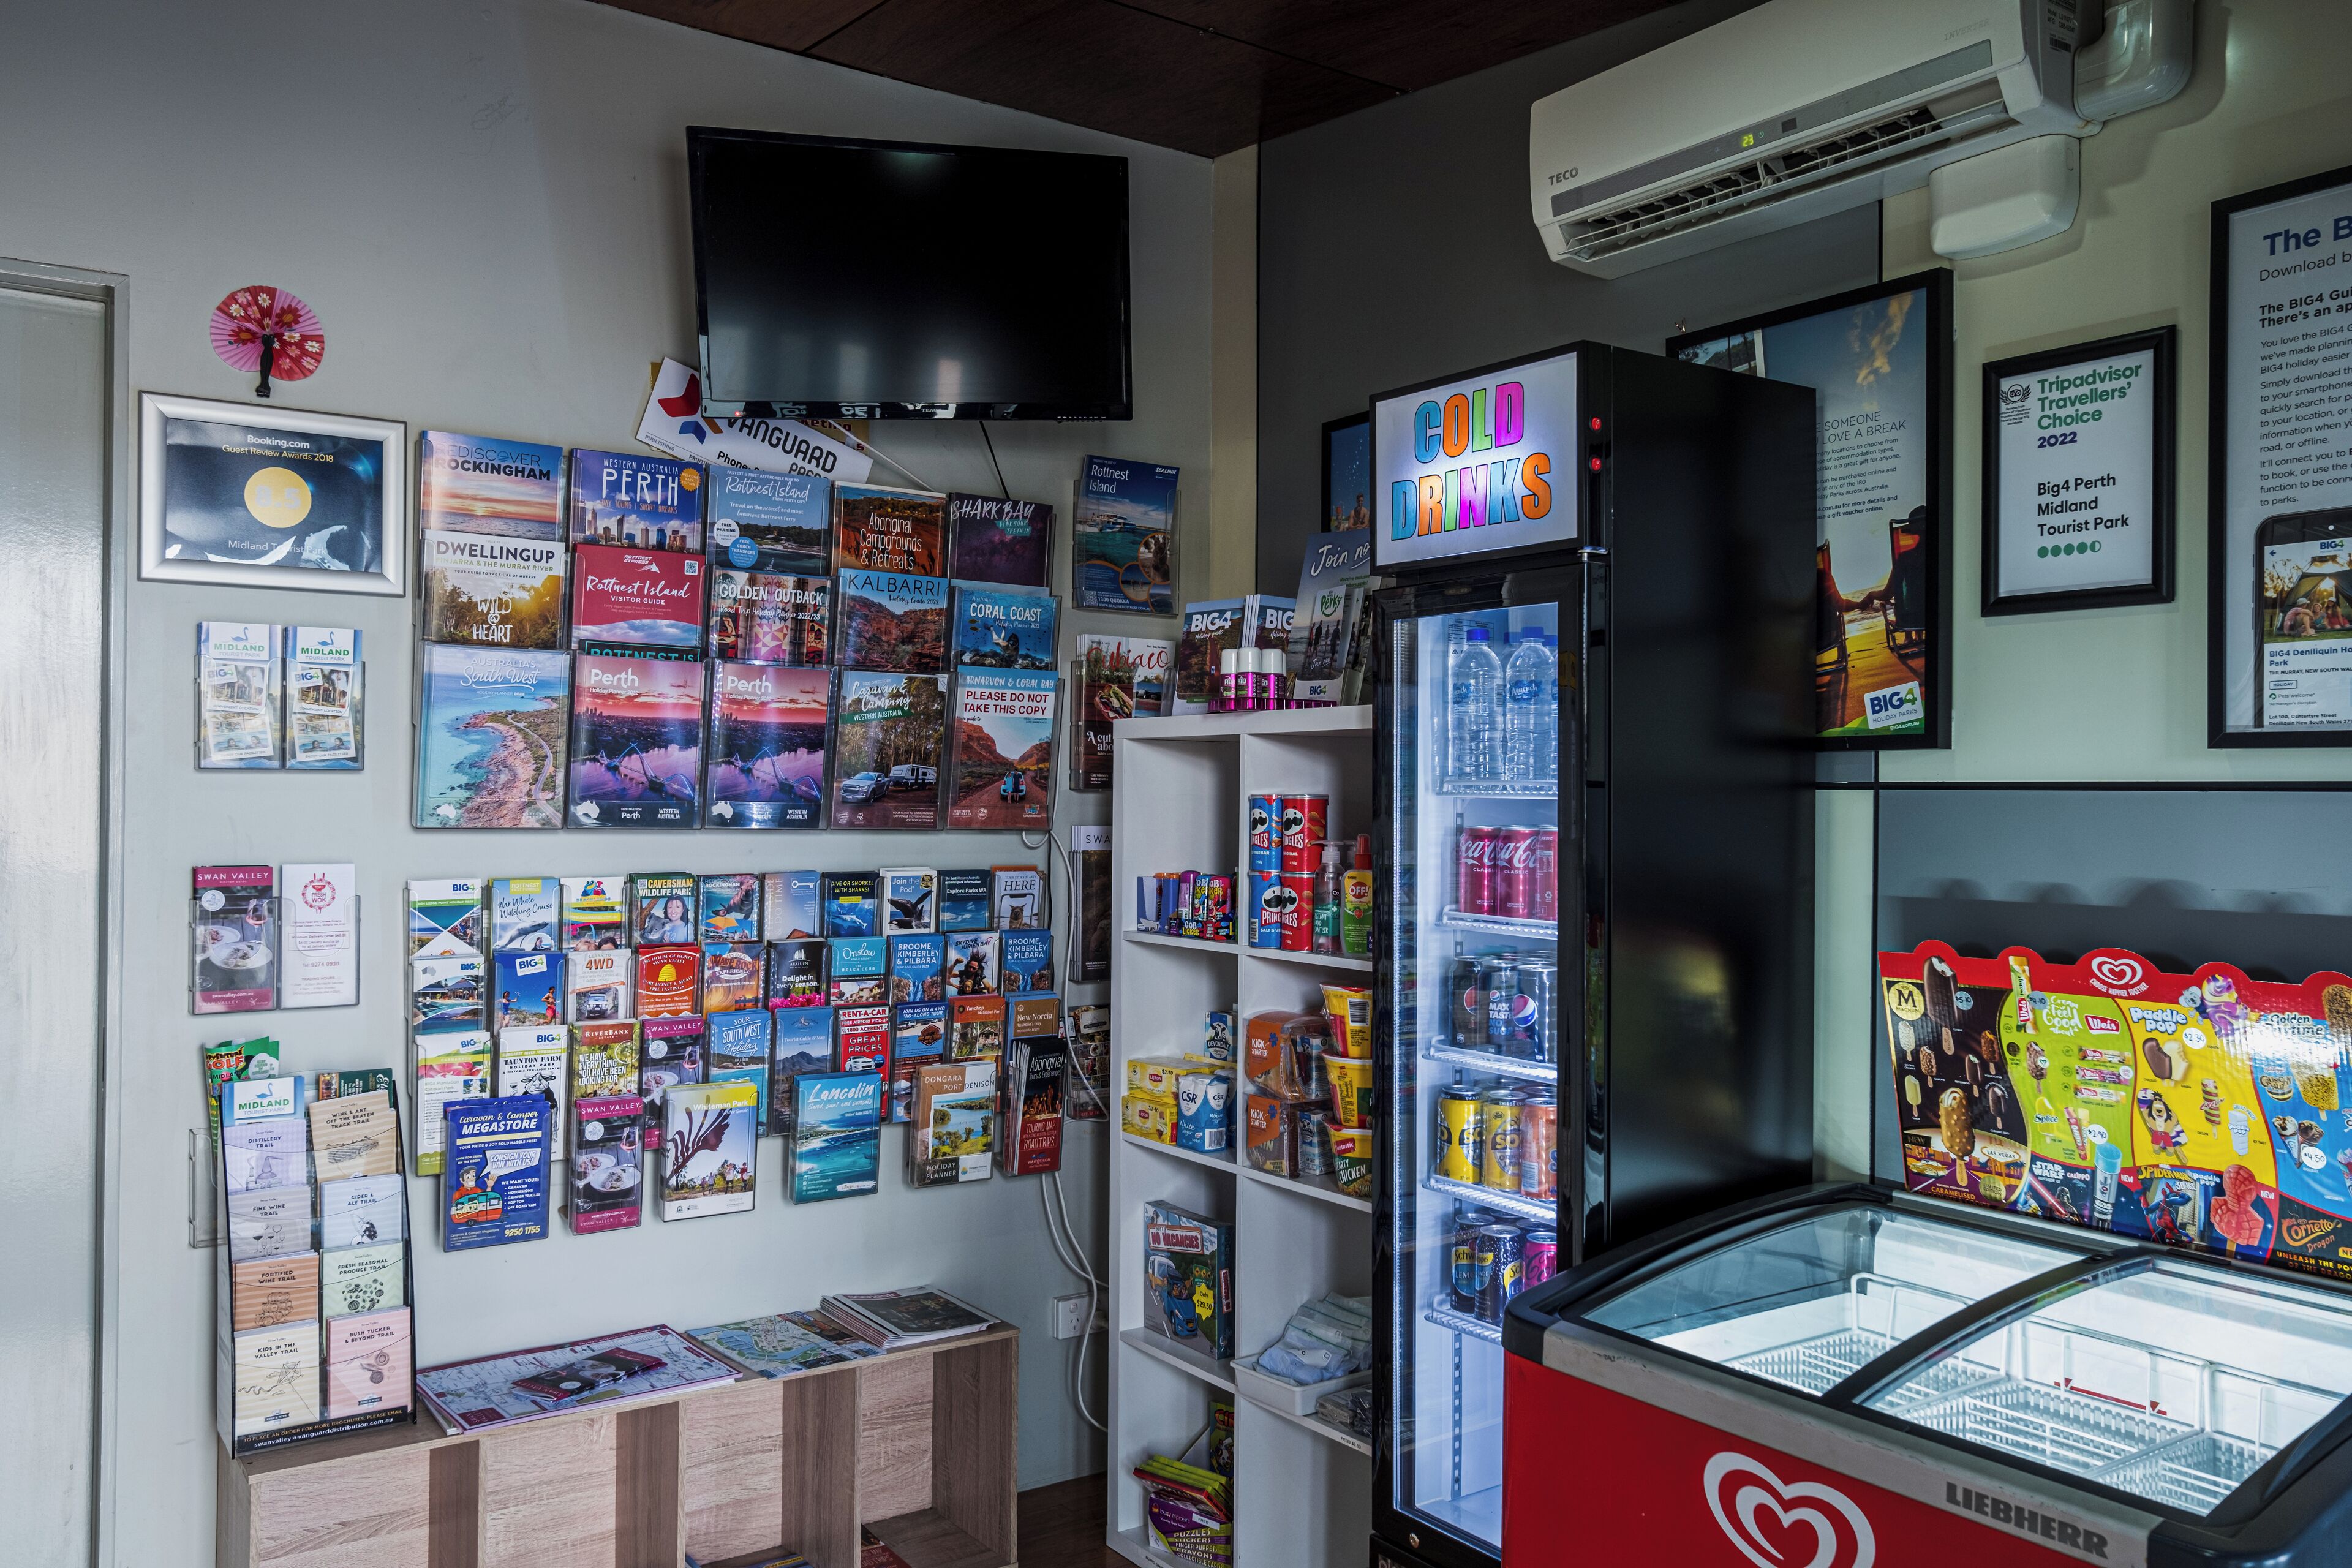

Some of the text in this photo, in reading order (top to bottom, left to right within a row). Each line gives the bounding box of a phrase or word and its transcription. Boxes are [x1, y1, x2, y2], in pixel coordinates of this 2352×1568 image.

[1741, 134, 1754, 148] 23
[1548, 167, 1578, 186] TECO
[2263, 228, 2321, 256] The
[2260, 254, 2335, 281] Download
[2260, 293, 2324, 315] The BIG4
[2037, 363, 2142, 396] Tripadvisor
[2261, 368, 2341, 391] Simply download
[1414, 381, 1524, 464] COLD
[1824, 410, 1882, 430] SOMEONE
[2037, 408, 2103, 431] Choice
[1822, 419, 1907, 445] LOVE A BREAK
[2260, 421, 2341, 440] information when
[247, 435, 310, 449] Booking.com
[727, 418, 837, 473] VANGUARD
[2037, 431, 2078, 449] 2022
[222, 445, 334, 462] Guest Review Awards 2018
[435, 458, 551, 481] ROCKINGHAM
[604, 458, 679, 474] WESTERN AUSTRALIA
[1091, 464, 1129, 480] Rottnest
[602, 468, 679, 506] PERTH
[726, 476, 810, 502] Rottnest Island
[1089, 480, 1117, 494] Island
[2037, 473, 2116, 497] Big4 Perth
[254, 485, 301, 508] 8.5
[1392, 453, 1551, 541] DRINKS
[601, 499, 677, 514] DAY TOURS SHORT BREAKS
[952, 499, 1035, 521] SHARK BAY
[2037, 496, 2098, 516] Midland
[869, 512, 913, 535] Aboriginal
[2037, 514, 2129, 537] Tourist Park
[228, 540, 268, 551] Midland
[859, 529, 922, 553] Campgrounds
[436, 540, 556, 564] DWELLINGUP
[861, 550, 914, 570] & Retreats
[1311, 544, 1348, 576] Join
[586, 575, 690, 599] Rottnest Island
[848, 574, 940, 597] KALBARRI
[611, 595, 639, 603] VISITOR
[720, 584, 823, 605] GOLDEN OUTBACK
[477, 595, 511, 614] WILD
[970, 603, 1042, 621] CORAL COAST
[1191, 611, 1232, 632] BIG4
[473, 623, 513, 643] HEART
[301, 647, 349, 656] MIDLAND
[2293, 647, 2337, 657] Deniliquin
[471, 657, 536, 669] AUSTRALIA'S
[461, 666, 541, 687] South West
[591, 668, 639, 688] Perth
[853, 682, 897, 700] Caravan
[966, 691, 1049, 703] PLEASE DO NOT
[1512, 683, 1538, 696] Aquench
[861, 695, 912, 711] Camping
[1869, 685, 1918, 714] BIG4
[964, 703, 1047, 715] TAKE THIS COPY
[1873, 708, 1918, 723] HOLIDAY PARKS
[453, 883, 475, 892] BIG4
[647, 879, 693, 888] CAVERSHAM
[1005, 880, 1036, 891] HERE
[1349, 883, 1368, 896] OFF!
[843, 943, 875, 959] Onslow
[585, 957, 614, 970] 4WD
[842, 1009, 887, 1017] RENT-A-CAR
[2088, 1016, 2117, 1031] Weis
[848, 1044, 882, 1053] PRICES
[850, 1035, 881, 1045] GREAT
[1208, 1041, 1230, 1050] DEVONDALE
[1252, 1039, 1264, 1048] KICK
[1252, 1048, 1267, 1057] STARTER
[964, 1080, 995, 1089] DENISON
[1149, 1073, 1163, 1083] Lipton
[807, 1083, 875, 1102] Lancelin
[1182, 1091, 1197, 1103] CSR
[238, 1099, 290, 1110] MIDLAND
[693, 1101, 731, 1110] Whiteman
[462, 1118, 538, 1135] MEGASTORE
[2035, 1113, 2058, 1123] Splice
[248, 1136, 282, 1144] DISTILLERY
[1998, 1151, 2016, 1159] VEGAS
[1338, 1165, 1366, 1183] CHICKEN
[505, 1226, 540, 1237] 9250 1755
[1152, 1231, 1200, 1250] NO VACANCIES
[2308, 1235, 2335, 1253] Dragon
[1197, 1301, 1212, 1311] $29.50
[368, 1326, 391, 1335] TUCKER
[1946, 1480, 2109, 1561] LIEBHERR
[1174, 1528, 1211, 1537] PUZZLES
